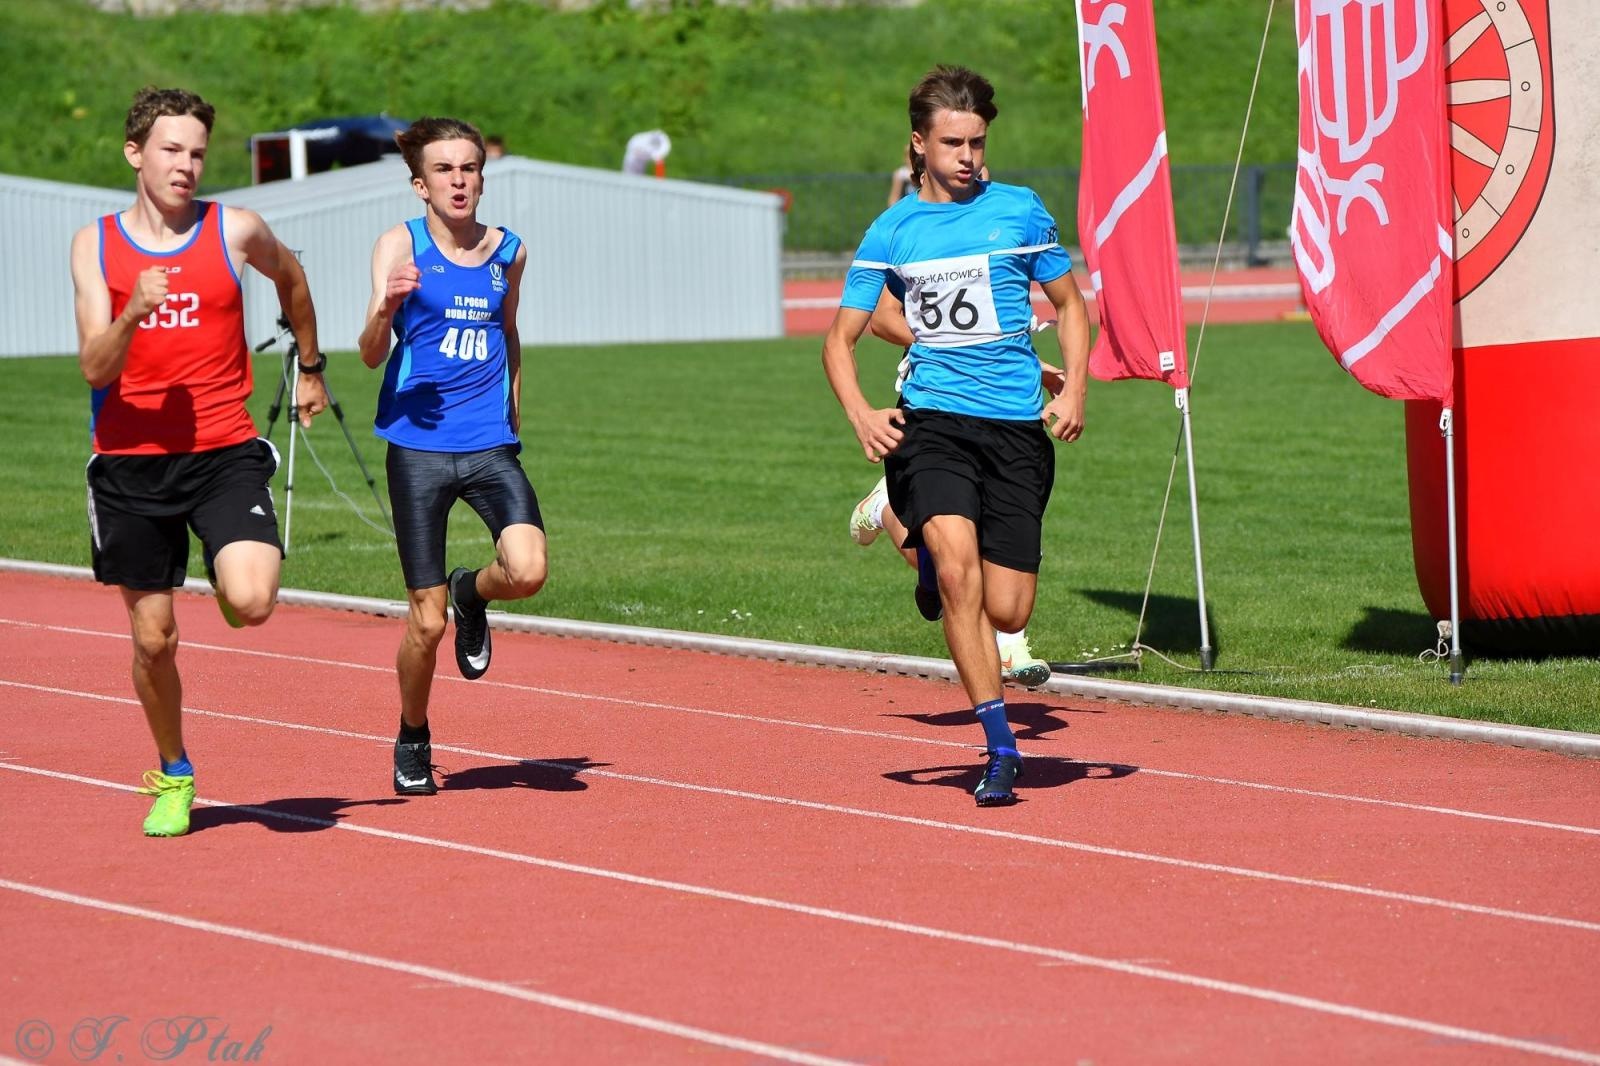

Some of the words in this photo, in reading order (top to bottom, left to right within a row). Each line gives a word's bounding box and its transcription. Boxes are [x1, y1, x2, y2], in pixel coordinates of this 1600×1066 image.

[445, 309, 467, 320] RUDA
[920, 288, 979, 331] 56
[439, 327, 488, 361] 409
